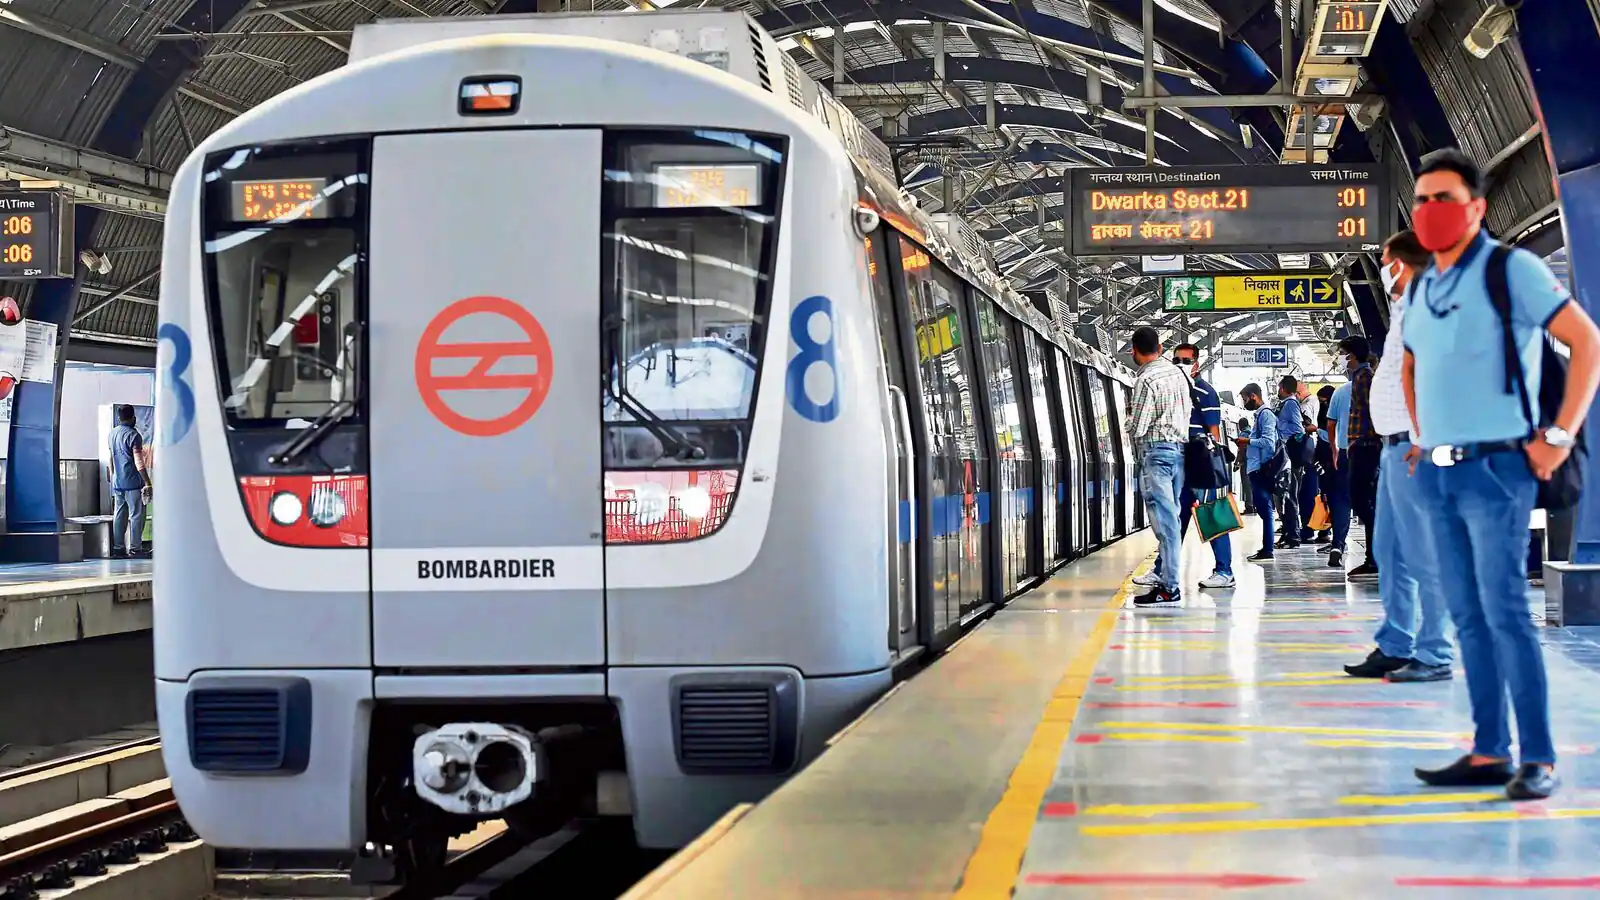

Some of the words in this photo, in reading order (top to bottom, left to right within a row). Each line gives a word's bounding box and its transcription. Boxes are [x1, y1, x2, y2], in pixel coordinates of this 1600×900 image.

[1090, 173, 1123, 184] गन्तव्य
[1091, 191, 1167, 211] Dwarka
[1173, 189, 1249, 210] Sect.21
[1337, 188, 1366, 207] :01
[3, 216, 33, 235] :06
[1091, 224, 1133, 240] द्वारका
[1139, 221, 1182, 240] सेक्टर
[1189, 219, 1214, 239] 21
[1337, 217, 1366, 237] :01
[3, 244, 33, 263] :06
[1243, 277, 1281, 291] निकास
[1257, 294, 1281, 305] Exit
[785, 295, 841, 424] 8
[417, 558, 556, 579] BOMBARDIER
